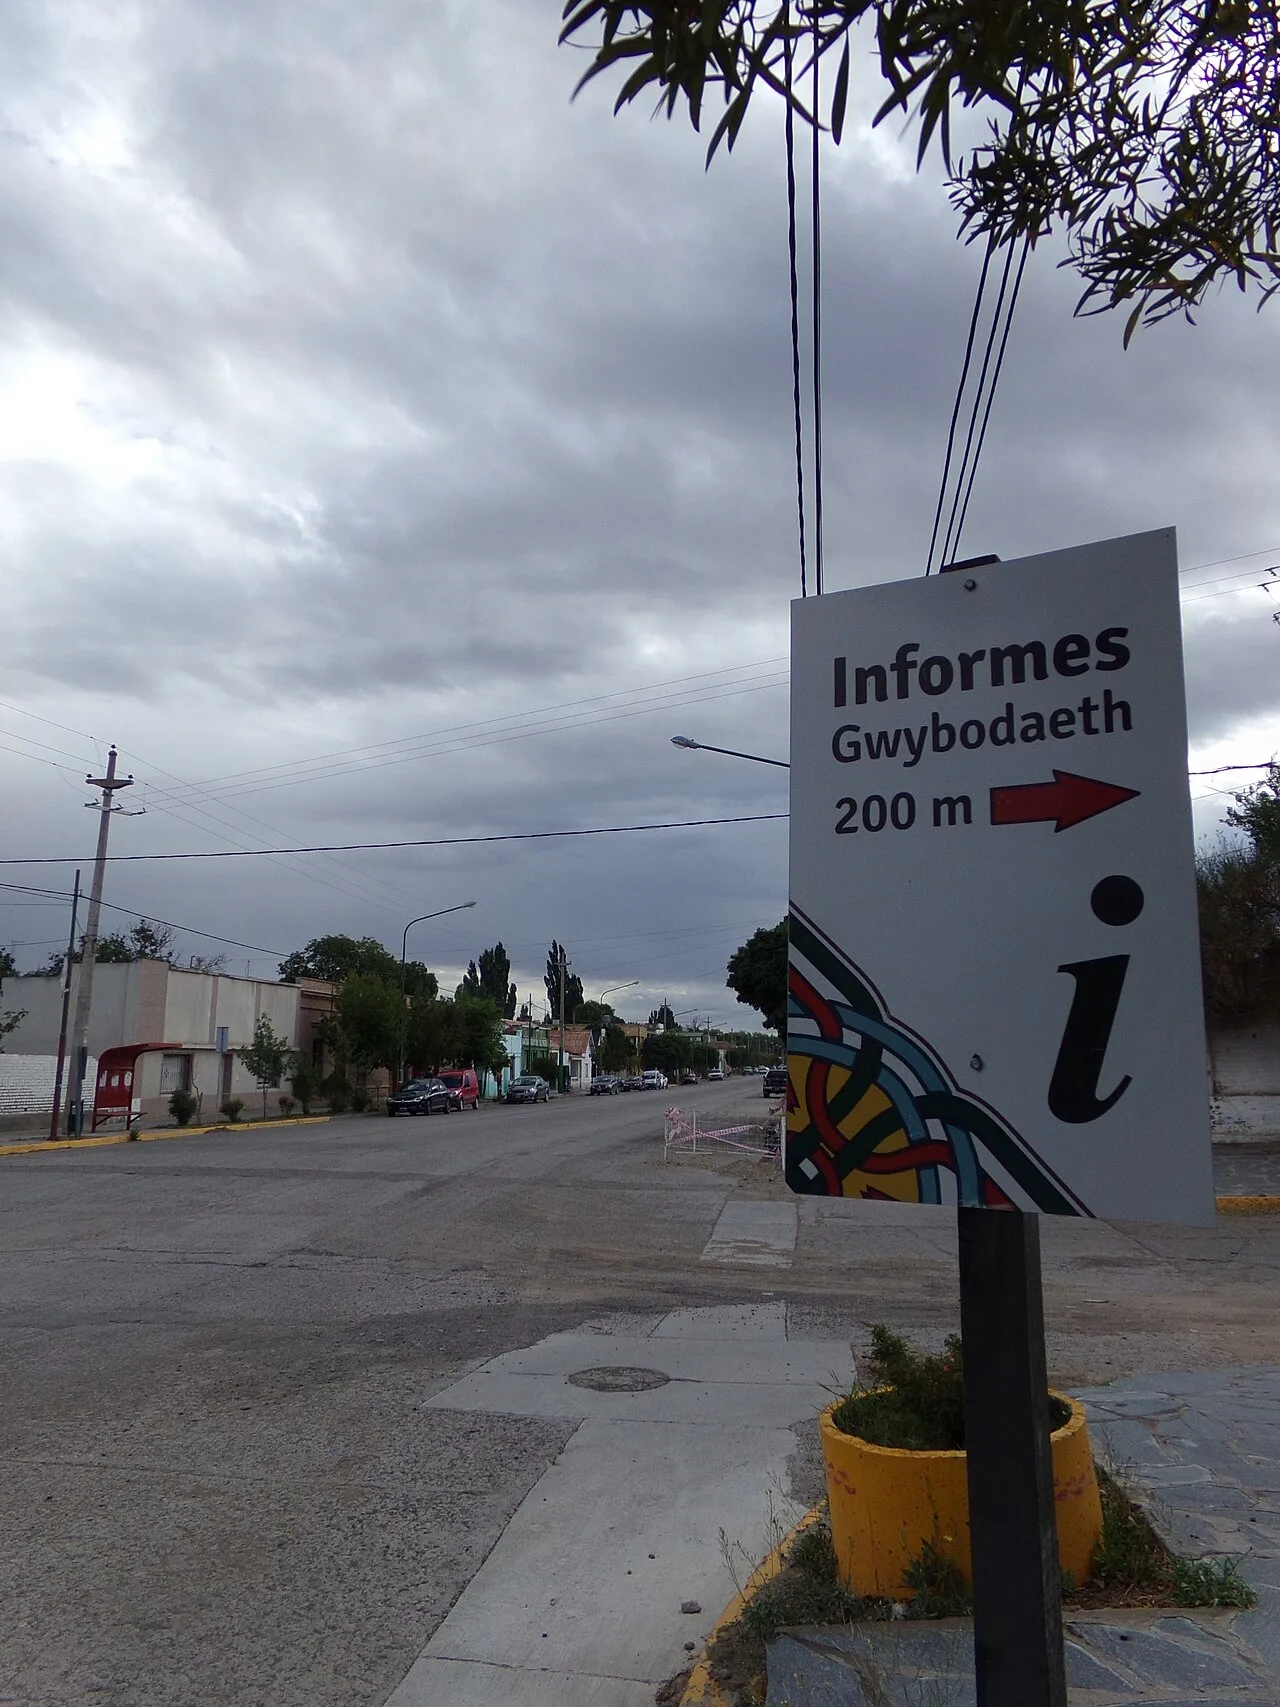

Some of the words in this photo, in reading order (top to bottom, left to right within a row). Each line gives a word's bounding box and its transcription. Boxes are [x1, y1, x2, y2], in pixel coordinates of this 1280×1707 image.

[834, 627, 1131, 707] Informes
[832, 689, 1133, 768] Gwybodaeth
[835, 792, 916, 834] 200
[933, 795, 972, 827] m
[1048, 875, 1144, 1123] i
